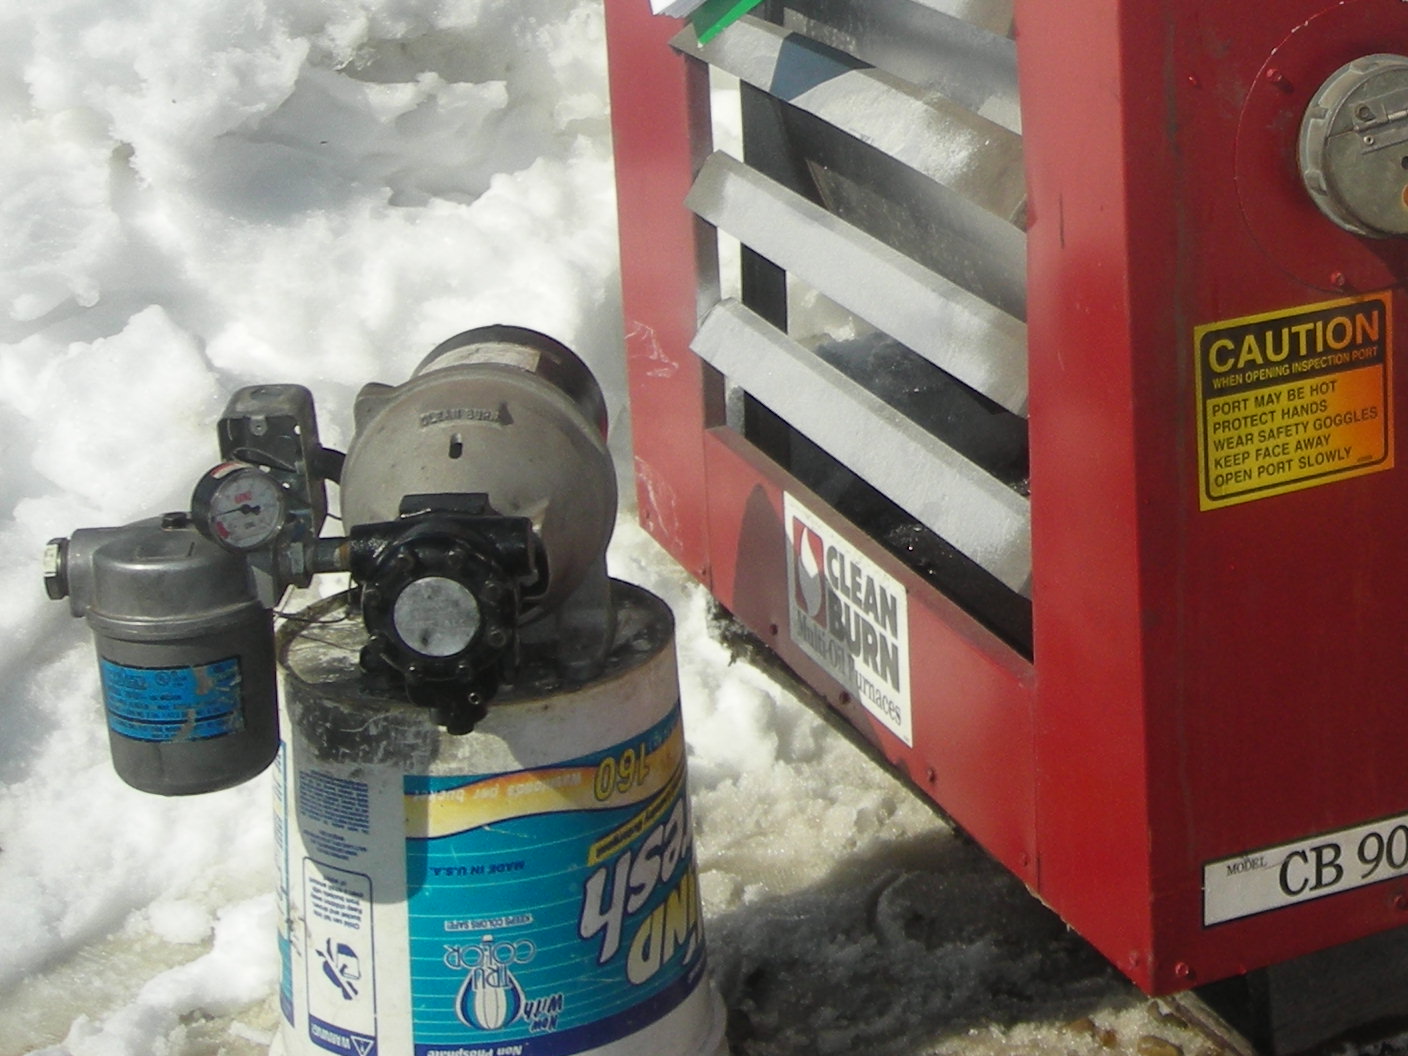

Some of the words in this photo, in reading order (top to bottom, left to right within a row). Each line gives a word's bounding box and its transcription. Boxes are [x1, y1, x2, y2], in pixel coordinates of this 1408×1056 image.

[1208, 310, 1380, 373] CAUTION
[1212, 370, 1243, 390] WHEN
[1245, 364, 1290, 384] OPENING
[1292, 352, 1350, 374] INSPECTION
[1351, 346, 1378, 362] PORT
[1212, 399, 1249, 417] PORT
[1254, 390, 1283, 409] MAY
[1287, 387, 1305, 402] BE
[1310, 380, 1338, 397] HOT
[1213, 410, 1276, 434] PROTECT
[1281, 399, 1328, 419] HANDS
[1213, 433, 1254, 452] WEAR
[1258, 421, 1310, 444] SAFETY
[1313, 406, 1378, 430] GOGGLES
[1214, 451, 1250, 470] KEEP
[1255, 443, 1290, 461] FACE
[1294, 434, 1332, 453] AWAY
[1214, 469, 1253, 488] OPEN
[1257, 459, 1294, 478] PORT
[1298, 446, 1352, 470] SLOWLY
[826, 546, 898, 641] CLEAN
[828, 583, 900, 693] BURN
[798, 608, 846, 676] Multi-Oil
[849, 652, 902, 726] Furnaces
[594, 741, 650, 802] 160
[430, 866, 467, 877] U.S.A.
[470, 865, 485, 876] IN
[488, 860, 525, 873] MADE
[1226, 855, 1267, 876] MODEL
[1279, 843, 1344, 896] CB
[472, 918, 503, 930] COLORS
[504, 915, 531, 927] KEEPS
[443, 939, 537, 970] COLOR
[472, 965, 512, 991] TRU
[524, 994, 563, 1020] With
[497, 1045, 523, 1056] Non
